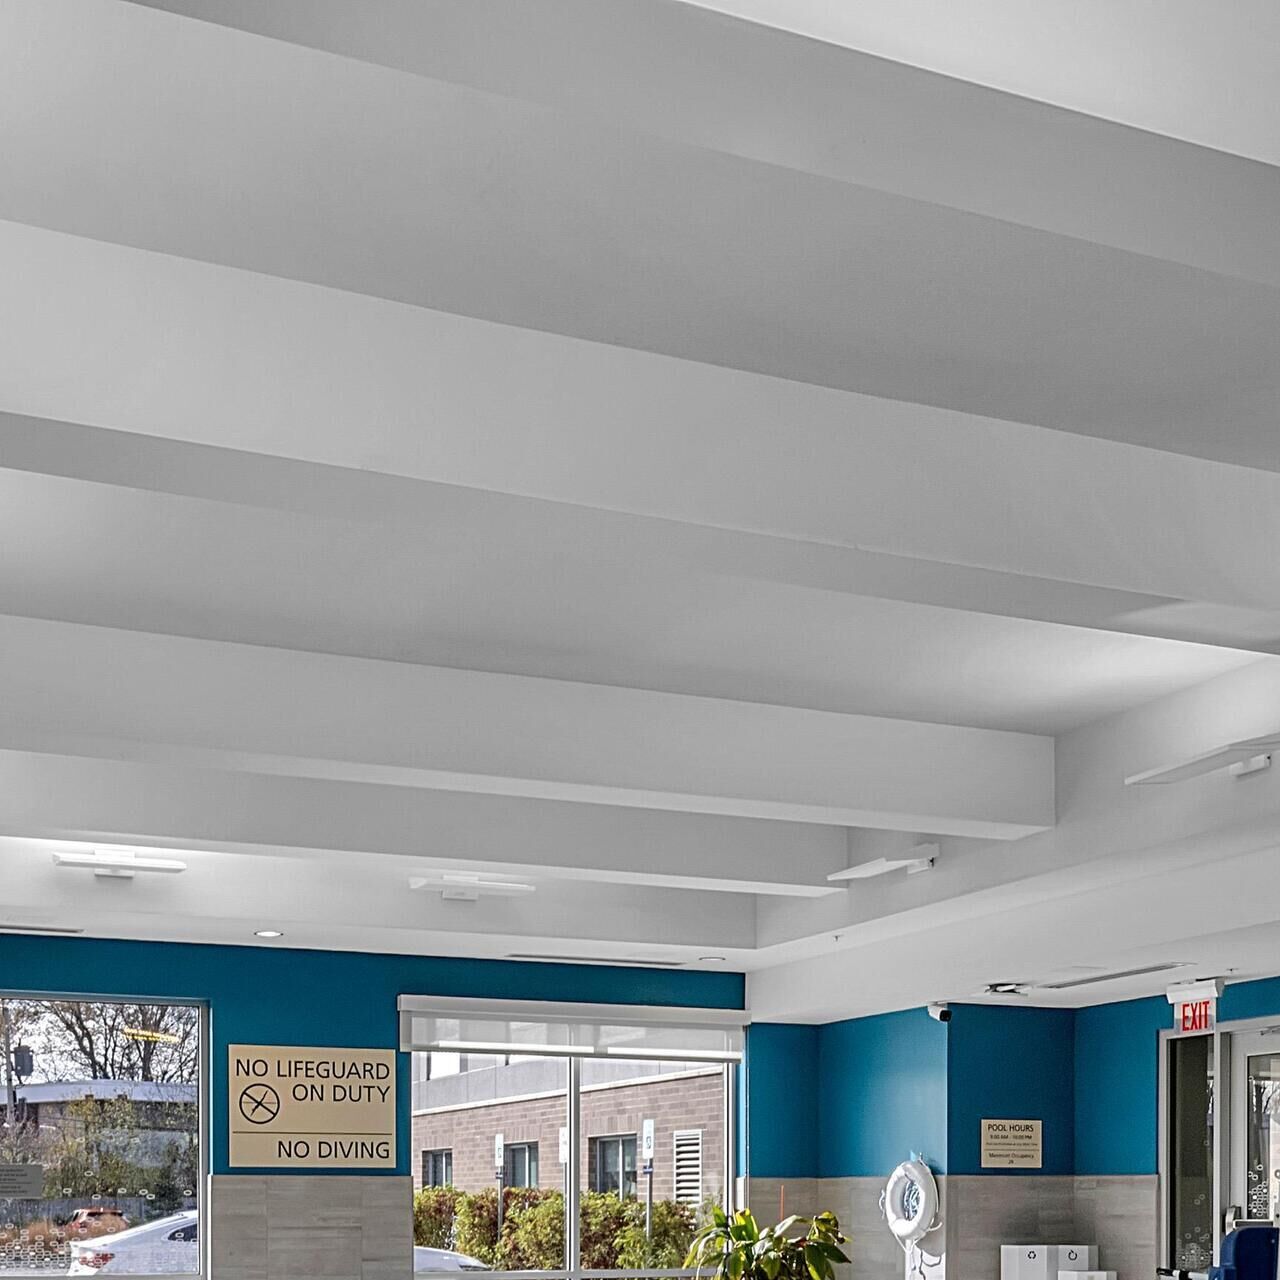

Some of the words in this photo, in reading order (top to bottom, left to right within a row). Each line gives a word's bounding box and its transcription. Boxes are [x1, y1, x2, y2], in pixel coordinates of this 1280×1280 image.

[1182, 1001, 1210, 1031] EXIT
[235, 1059, 269, 1077] NO
[277, 1060, 390, 1080] LIFEGUARD
[292, 1084, 324, 1102] ON
[333, 1085, 391, 1103] DUTY
[1009, 1124, 1034, 1132] HOURS
[278, 1140, 310, 1158] NO
[318, 1141, 390, 1159] DIVING
